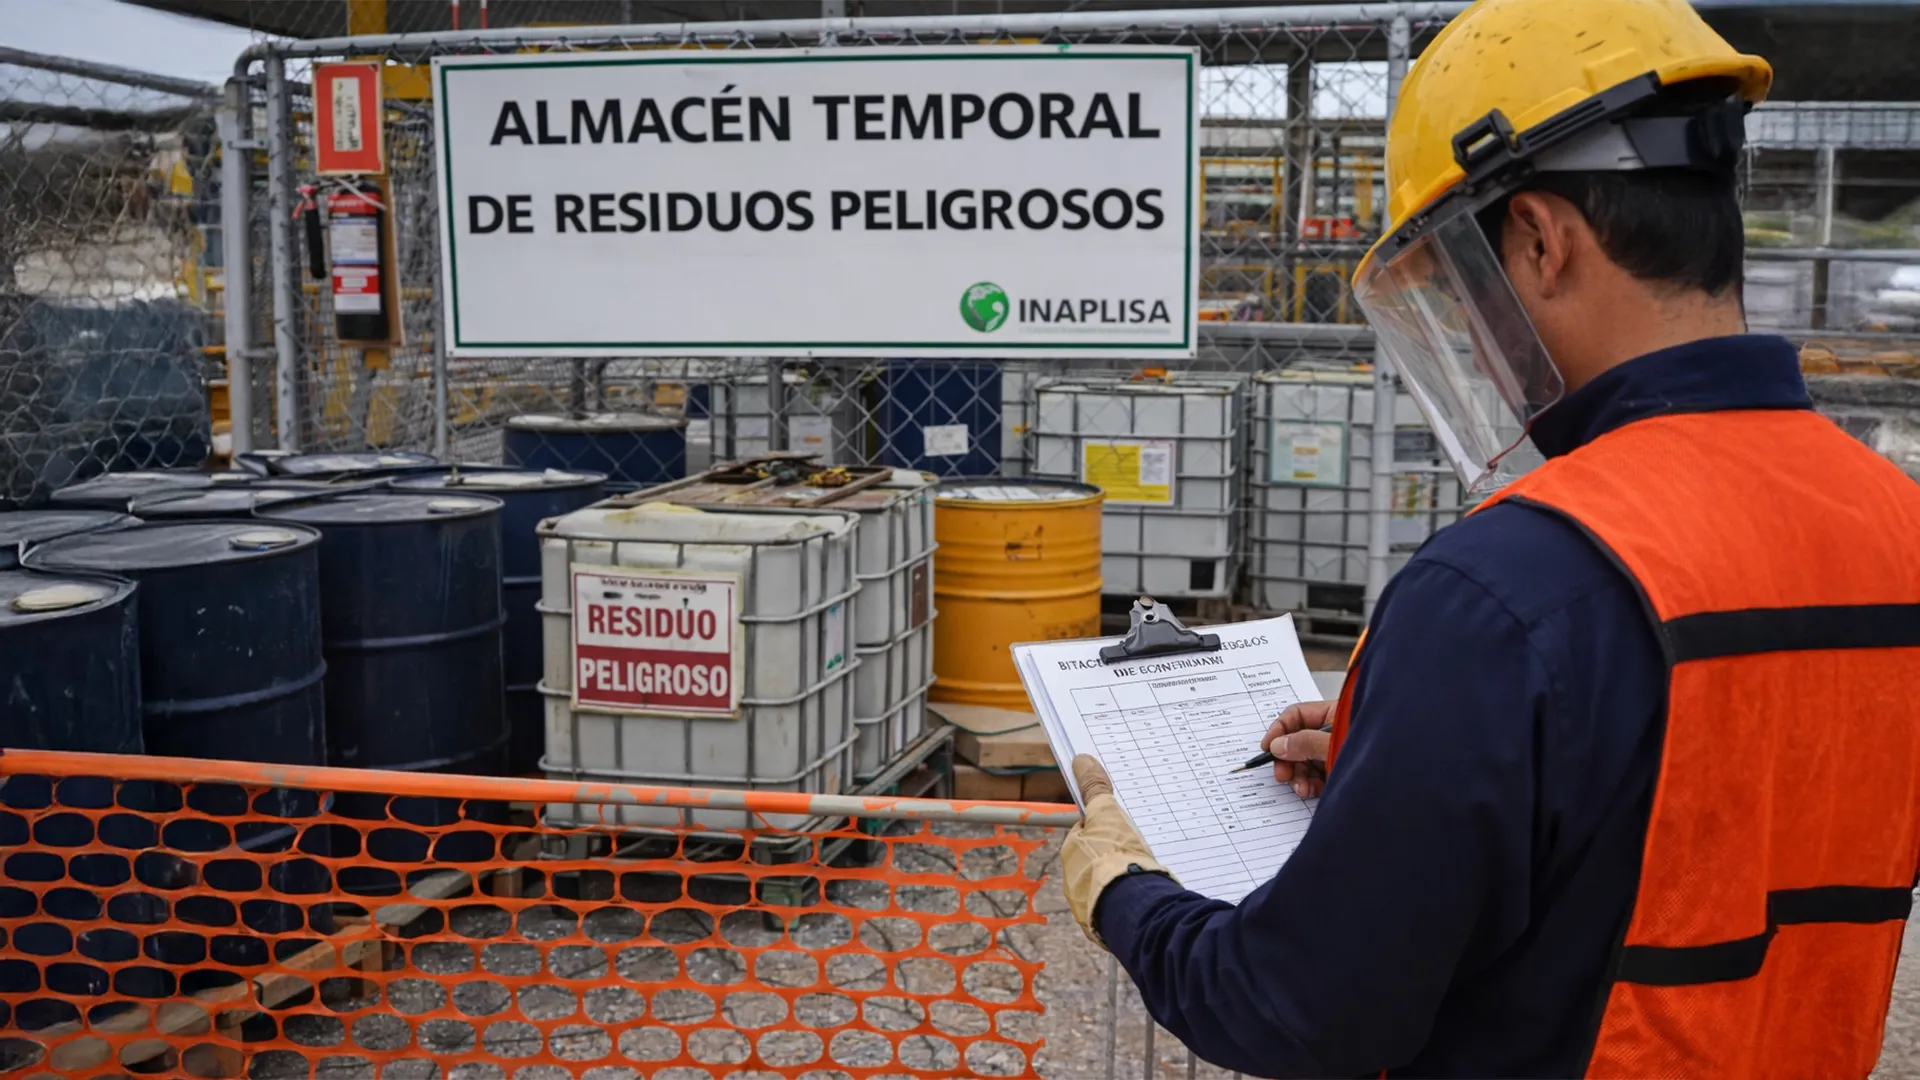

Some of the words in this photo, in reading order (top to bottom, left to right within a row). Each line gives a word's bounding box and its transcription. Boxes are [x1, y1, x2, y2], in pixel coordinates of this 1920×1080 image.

[489, 83, 791, 146] ALMACÉN
[812, 92, 1161, 141] TEMPORAL
[468, 194, 534, 235] DE
[555, 190, 815, 234] RESIDUOS
[831, 187, 1165, 231] PELIGROSOS
[1019, 299, 1171, 324] INAPLISA
[587, 604, 717, 640] RESIDUO
[578, 657, 729, 698] PELIGROSO
